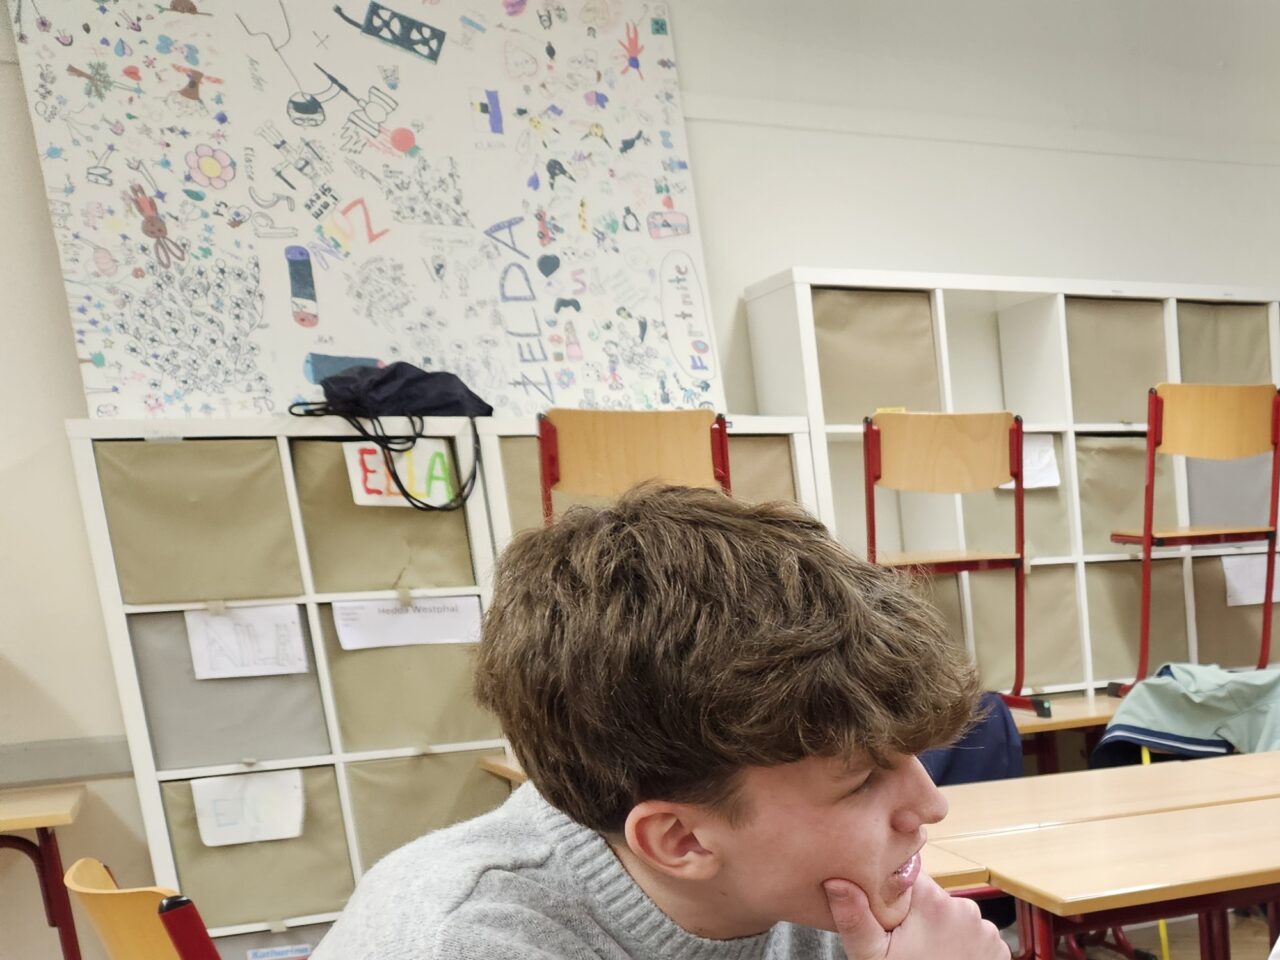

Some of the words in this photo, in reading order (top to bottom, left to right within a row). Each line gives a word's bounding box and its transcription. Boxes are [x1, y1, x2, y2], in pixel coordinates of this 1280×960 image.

[483, 215, 555, 404] ZELDA
[357, 447, 456, 503] ELLA
[411, 603, 459, 615] Westphal
